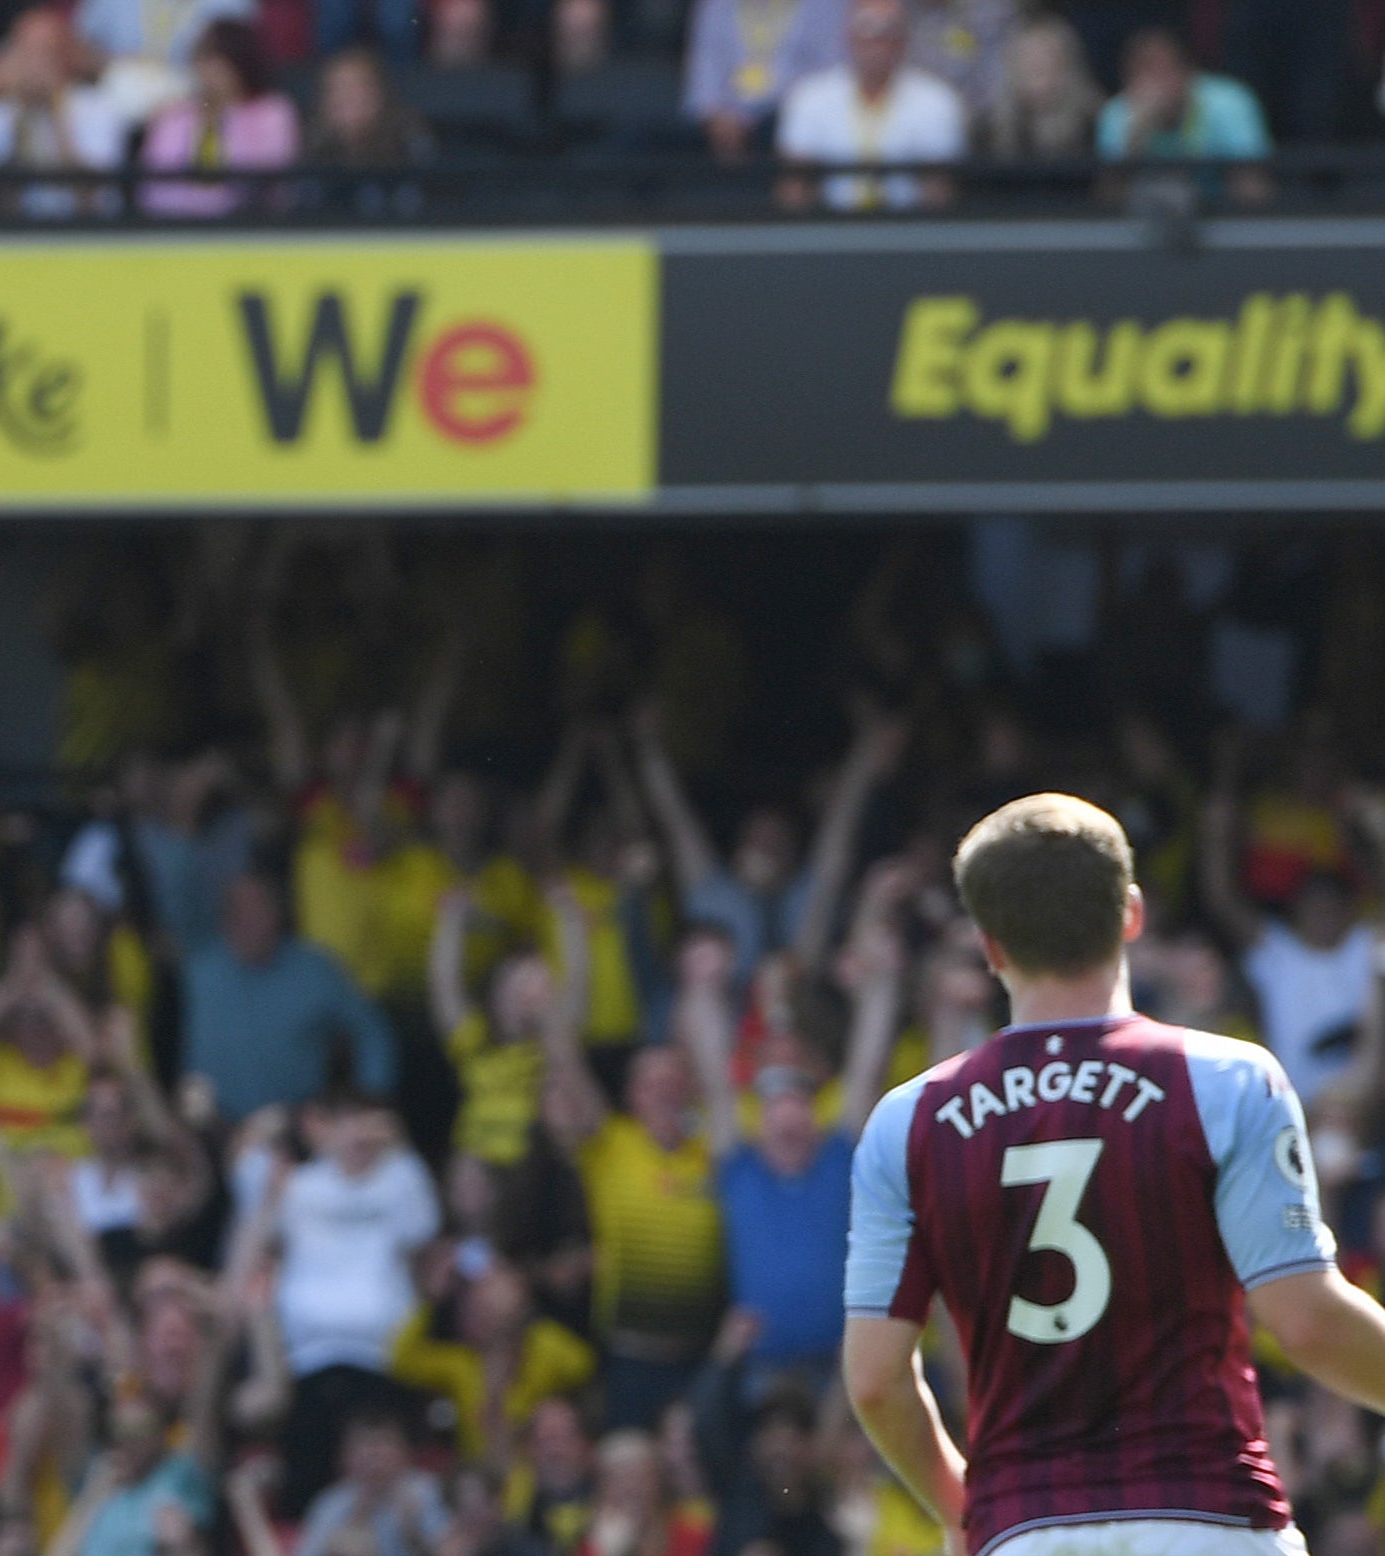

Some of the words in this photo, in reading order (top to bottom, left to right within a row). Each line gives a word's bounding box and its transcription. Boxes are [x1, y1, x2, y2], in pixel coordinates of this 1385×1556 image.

[236, 282, 538, 447] We
[936, 1060, 1165, 1138] TARGETT
[1000, 1138, 1112, 1344] 3
